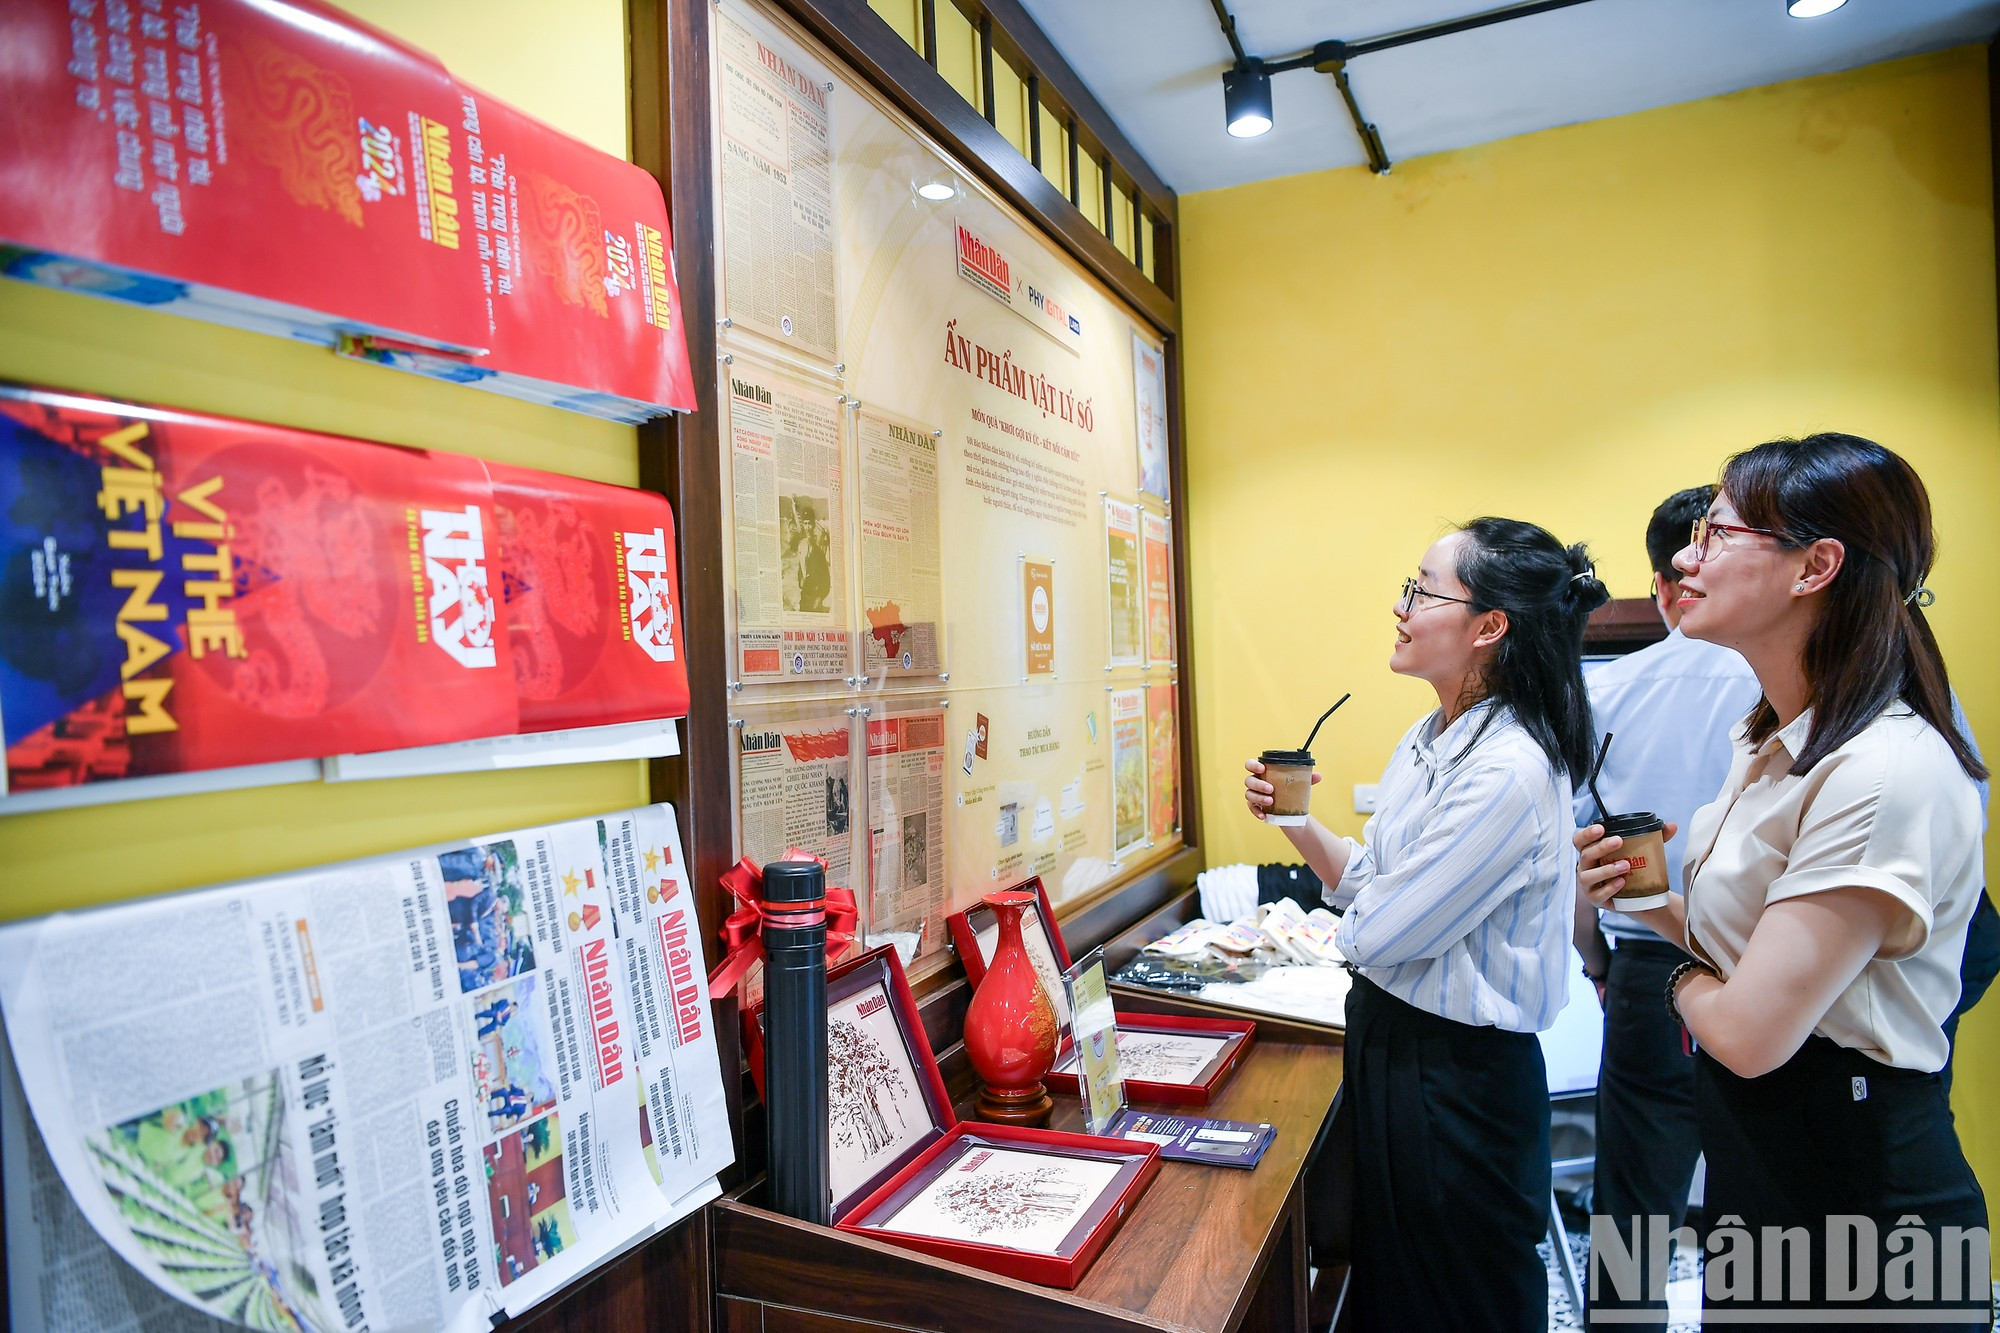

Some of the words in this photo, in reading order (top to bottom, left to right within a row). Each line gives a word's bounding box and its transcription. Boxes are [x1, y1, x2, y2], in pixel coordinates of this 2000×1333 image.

[756, 41, 796, 88] NHÂN
[797, 72, 826, 110] DÂN
[359, 117, 398, 196] 2024
[426, 119, 453, 194] Nhân
[434, 192, 460, 250] Dân
[604, 230, 631, 291] 2024
[647, 227, 666, 286] Nhân
[959, 225, 989, 273] Nhân
[988, 246, 1010, 286] Dân
[653, 285, 671, 331] Dân
[944, 318, 971, 374] ẤN
[975, 349, 1027, 401] PHẨM
[1029, 373, 1056, 419] VẬT
[1059, 388, 1074, 424] LÝ
[1077, 397, 1094, 433] SỐ
[732, 378, 755, 400] Nhân
[755, 383, 772, 405] Dân
[888, 424, 916, 445] NHÂN
[916, 434, 936, 452] DÂN
[97, 421, 166, 562] VIỆT
[614, 531, 624, 542] ẤN
[615, 544, 625, 566] PHẨM
[421, 510, 463, 668] NAY
[617, 568, 626, 583] CỦA
[181, 545, 249, 659] THẾ
[619, 585, 627, 600] BÁO
[624, 532, 653, 662] NAY
[620, 602, 629, 623] NHÂN
[622, 625, 631, 641] DÂN
[111, 569, 180, 735] NAM
[764, 731, 781, 749] Dân
[584, 938, 613, 1022] Nhân
[662, 909, 692, 985] Nhân
[677, 984, 702, 1044] Dân
[856, 998, 874, 1017] Nhân
[872, 994, 887, 1010] Dân
[598, 1020, 624, 1086] Dân
[426, 1119, 443, 1147] đáp
[443, 1098, 467, 1145] Chuẩn
[429, 1147, 445, 1177] ứng
[450, 1144, 467, 1174] hóa
[433, 1182, 452, 1208] yêu
[453, 1175, 471, 1199] đội
[438, 1208, 458, 1237] cầu
[457, 1199, 475, 1228] ngũ
[442, 1237, 461, 1263] đổi
[461, 1228, 478, 1258] nhà
[446, 1263, 462, 1293] mới
[463, 1257, 481, 1291] giáo
